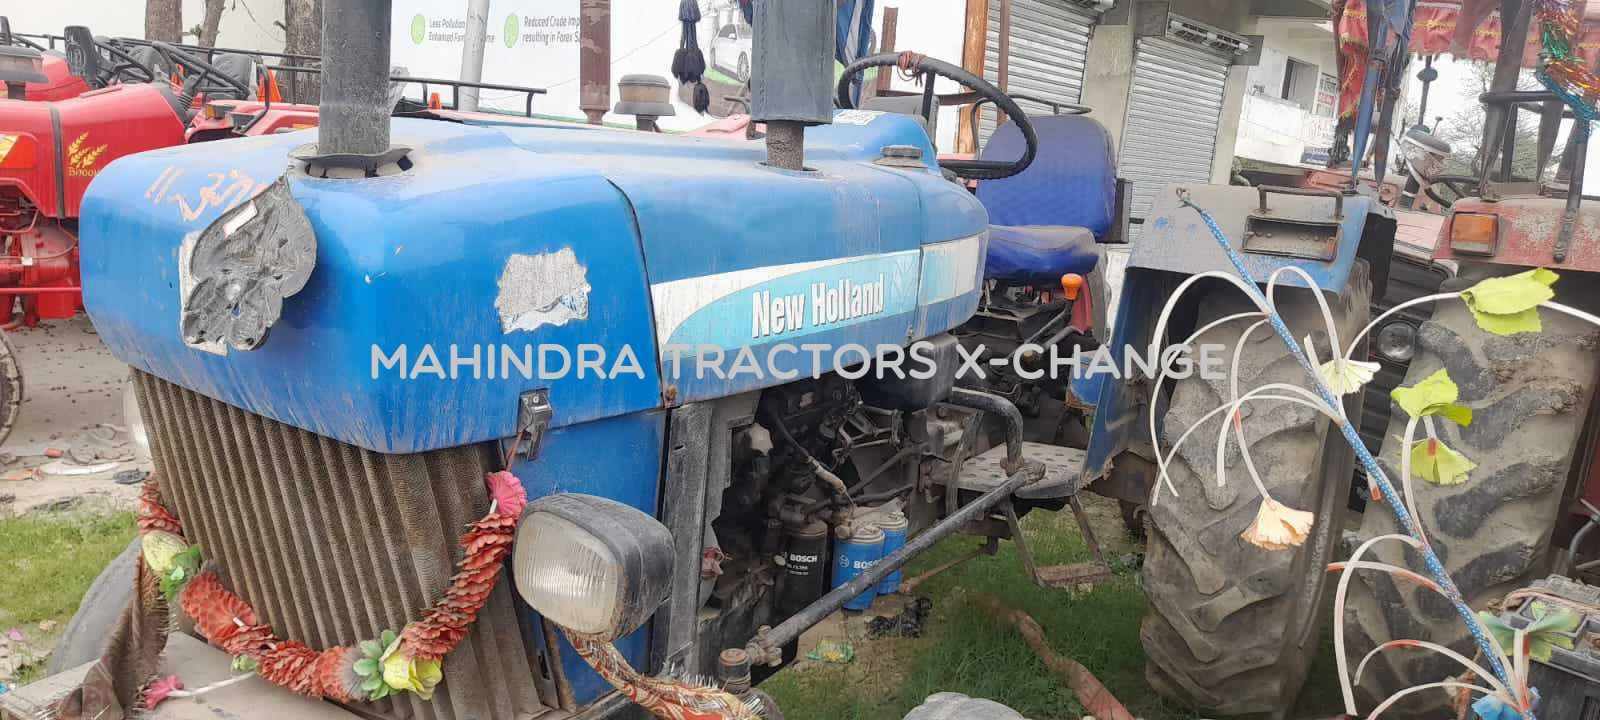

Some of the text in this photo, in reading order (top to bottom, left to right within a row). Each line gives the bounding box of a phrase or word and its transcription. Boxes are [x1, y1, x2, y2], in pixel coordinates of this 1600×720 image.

[523, 16, 549, 27] Reduced
[550, 16, 567, 27] Crude
[522, 32, 549, 45] resulting
[550, 32, 556, 42] in
[557, 31, 573, 43] Forex
[752, 272, 884, 338] New Holland
[790, 553, 818, 563] BOSCH
